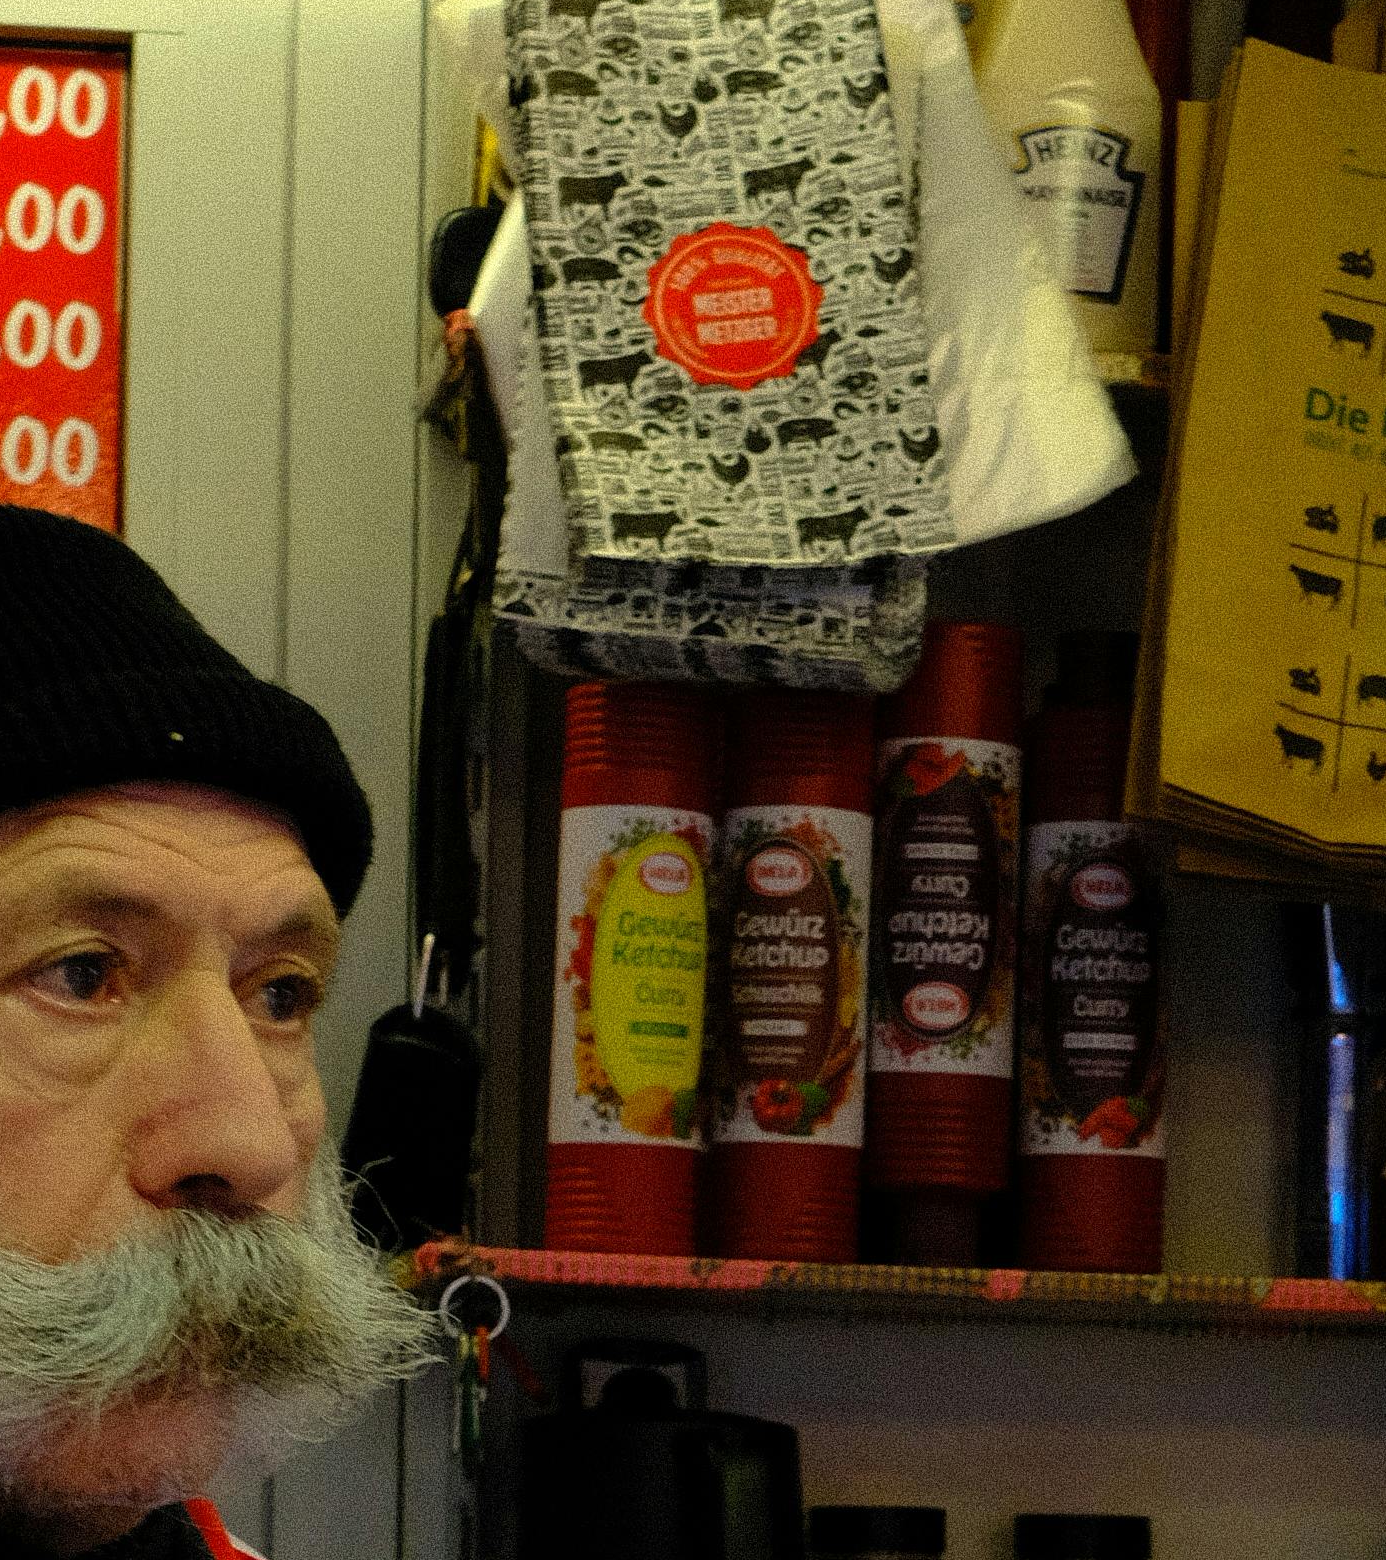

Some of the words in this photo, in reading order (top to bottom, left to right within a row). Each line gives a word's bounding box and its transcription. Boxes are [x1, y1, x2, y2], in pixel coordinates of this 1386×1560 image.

[1304, 385, 1371, 434] Die
[910, 873, 971, 899] Curry
[733, 907, 827, 940] Gewürz
[889, 909, 991, 940] Ketchup
[730, 940, 831, 971] Ketchup
